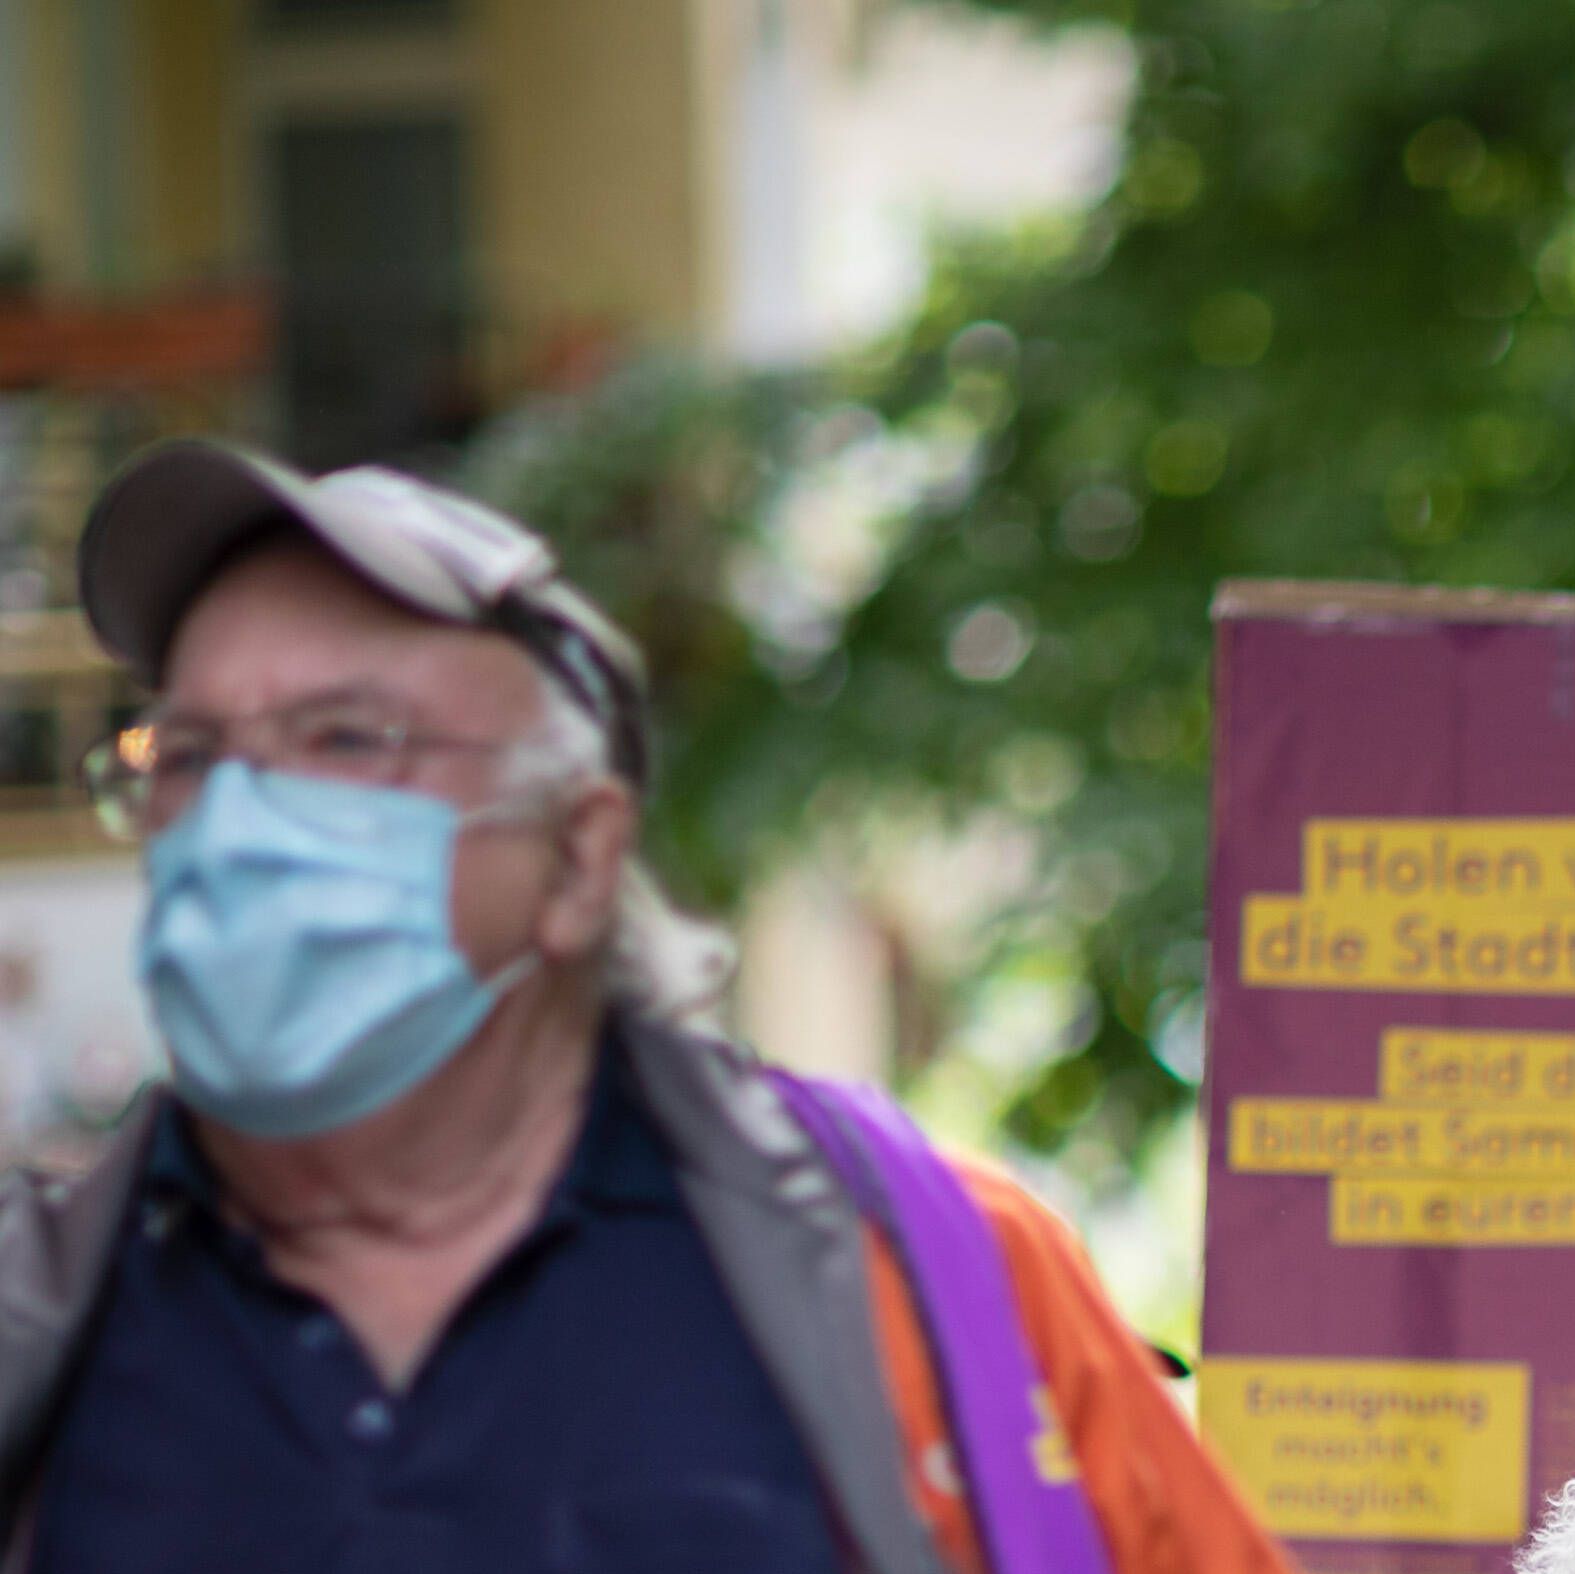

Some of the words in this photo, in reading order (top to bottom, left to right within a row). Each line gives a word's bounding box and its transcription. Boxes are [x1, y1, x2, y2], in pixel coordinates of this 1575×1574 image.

[1322, 835, 1543, 894] Holen
[1256, 912, 1367, 973] die
[1399, 1049, 1525, 1097] Seid
[1249, 1114, 1420, 1160] bildet
[1346, 1181, 1400, 1227] in
[1245, 1376, 1489, 1434] Enteignung
